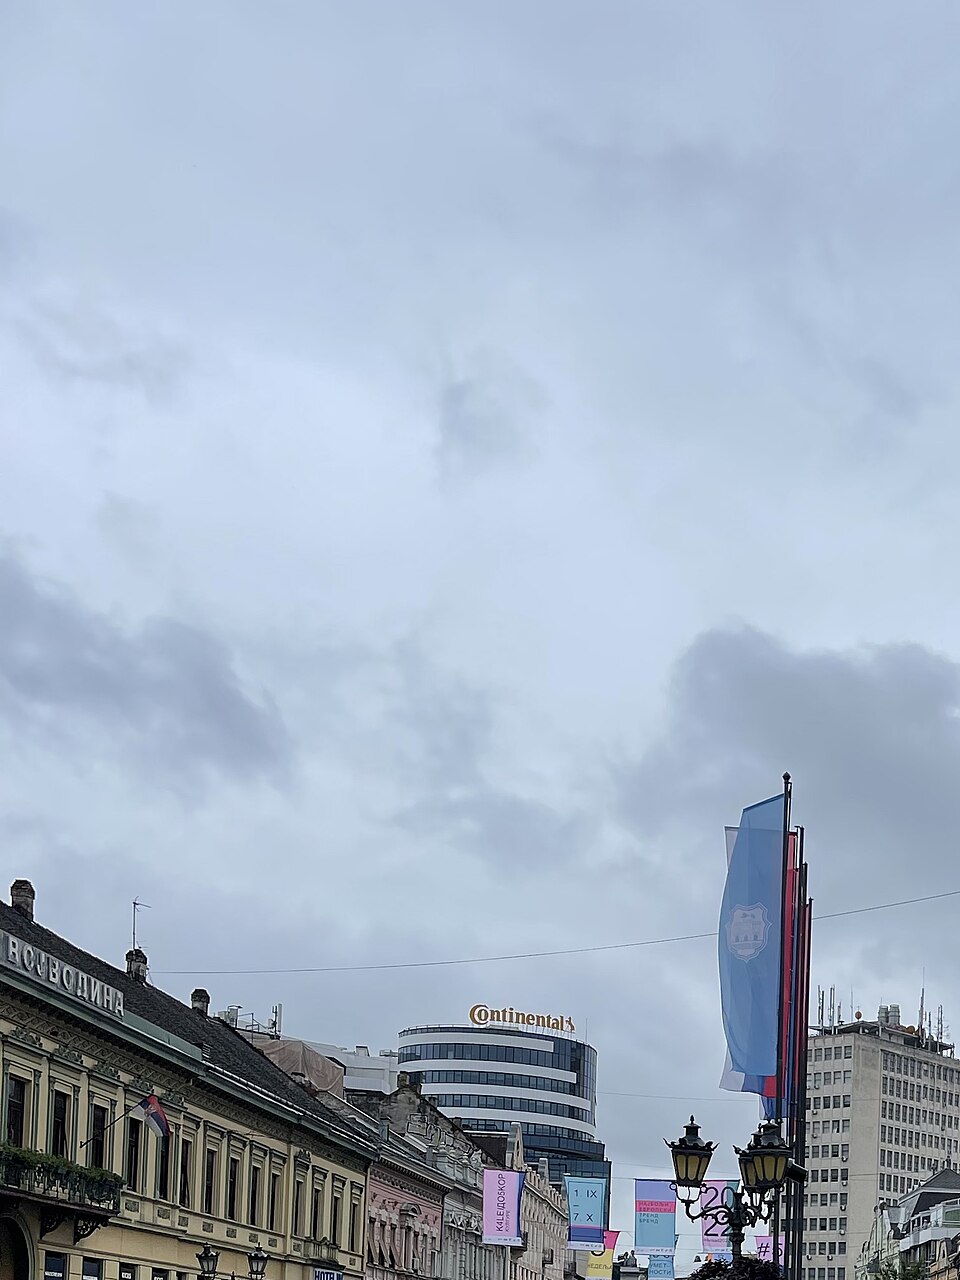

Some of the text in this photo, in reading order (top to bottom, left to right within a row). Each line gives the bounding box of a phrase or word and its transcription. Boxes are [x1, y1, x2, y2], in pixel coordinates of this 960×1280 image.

[8, 935, 124, 1017] ВОЈВОДИНА
[469, 1004, 565, 1031] Continental
[586, 1189, 597, 1198] IX
[703, 1187, 737, 1210] 20
[586, 1213, 593, 1222] X
